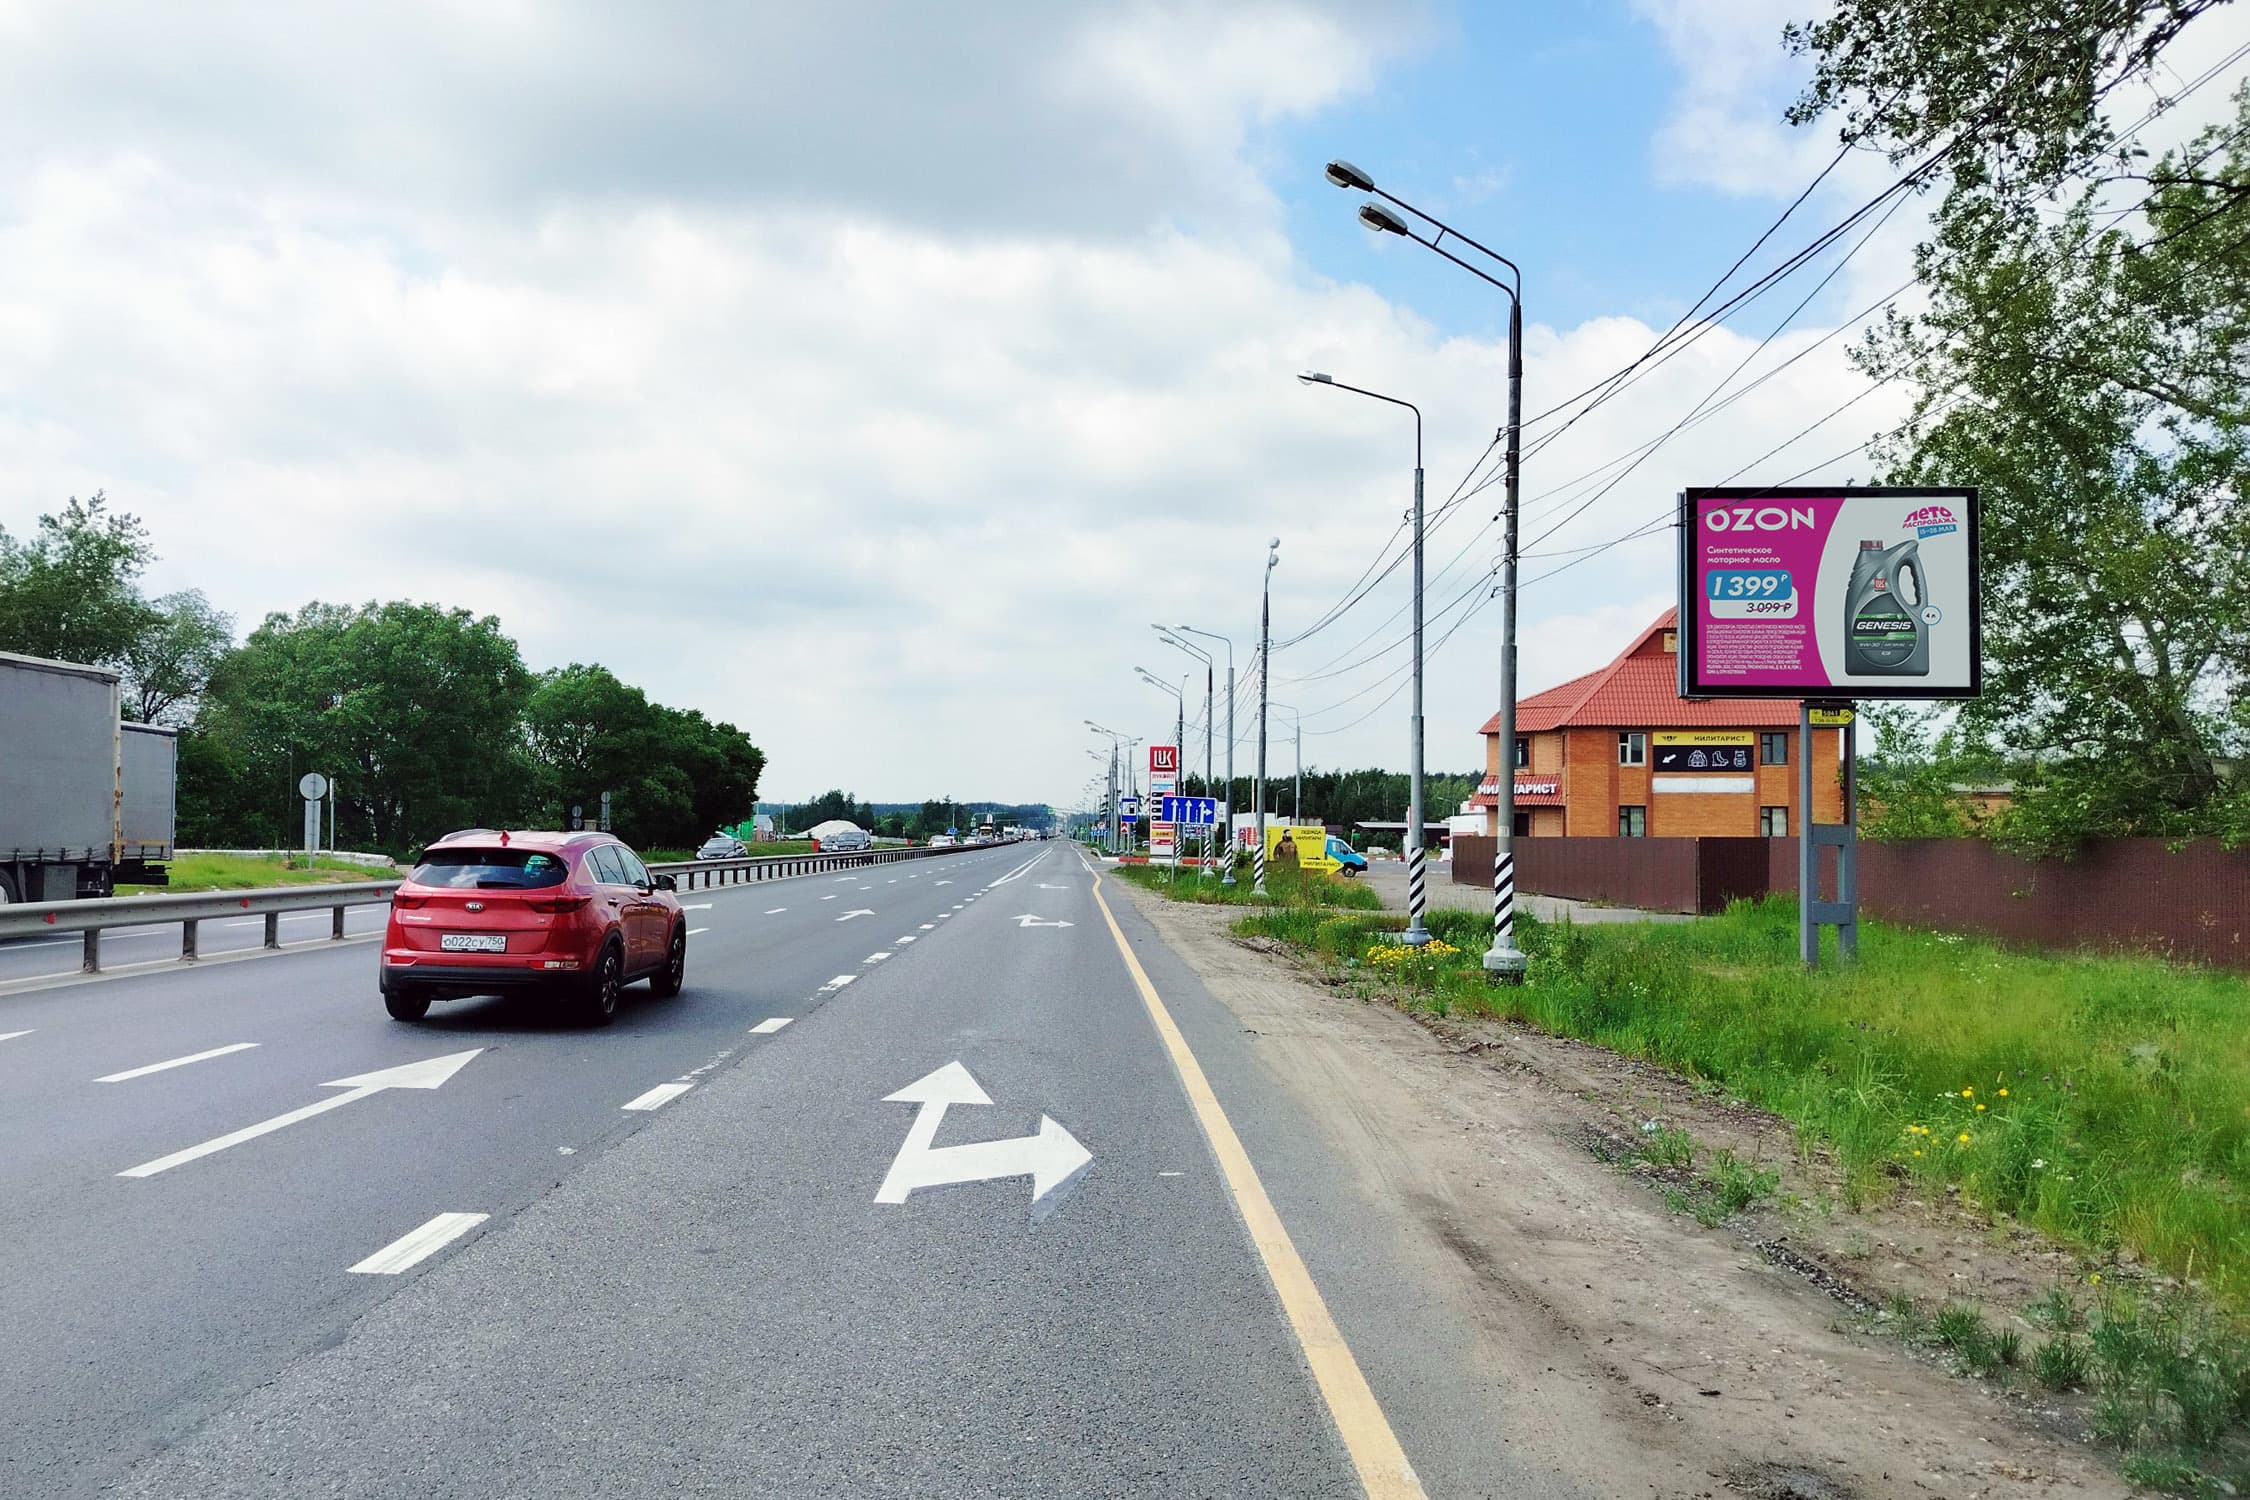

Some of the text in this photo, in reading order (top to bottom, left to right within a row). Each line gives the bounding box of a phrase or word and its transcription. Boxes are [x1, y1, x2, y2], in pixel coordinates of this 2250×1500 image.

[1705, 507, 1815, 532] OZON
[1707, 545, 1773, 555] Синтетическое
[1707, 557, 1750, 565] моторное
[1856, 621, 1912, 630] GENESIS
[486, 936, 502, 946] 750
